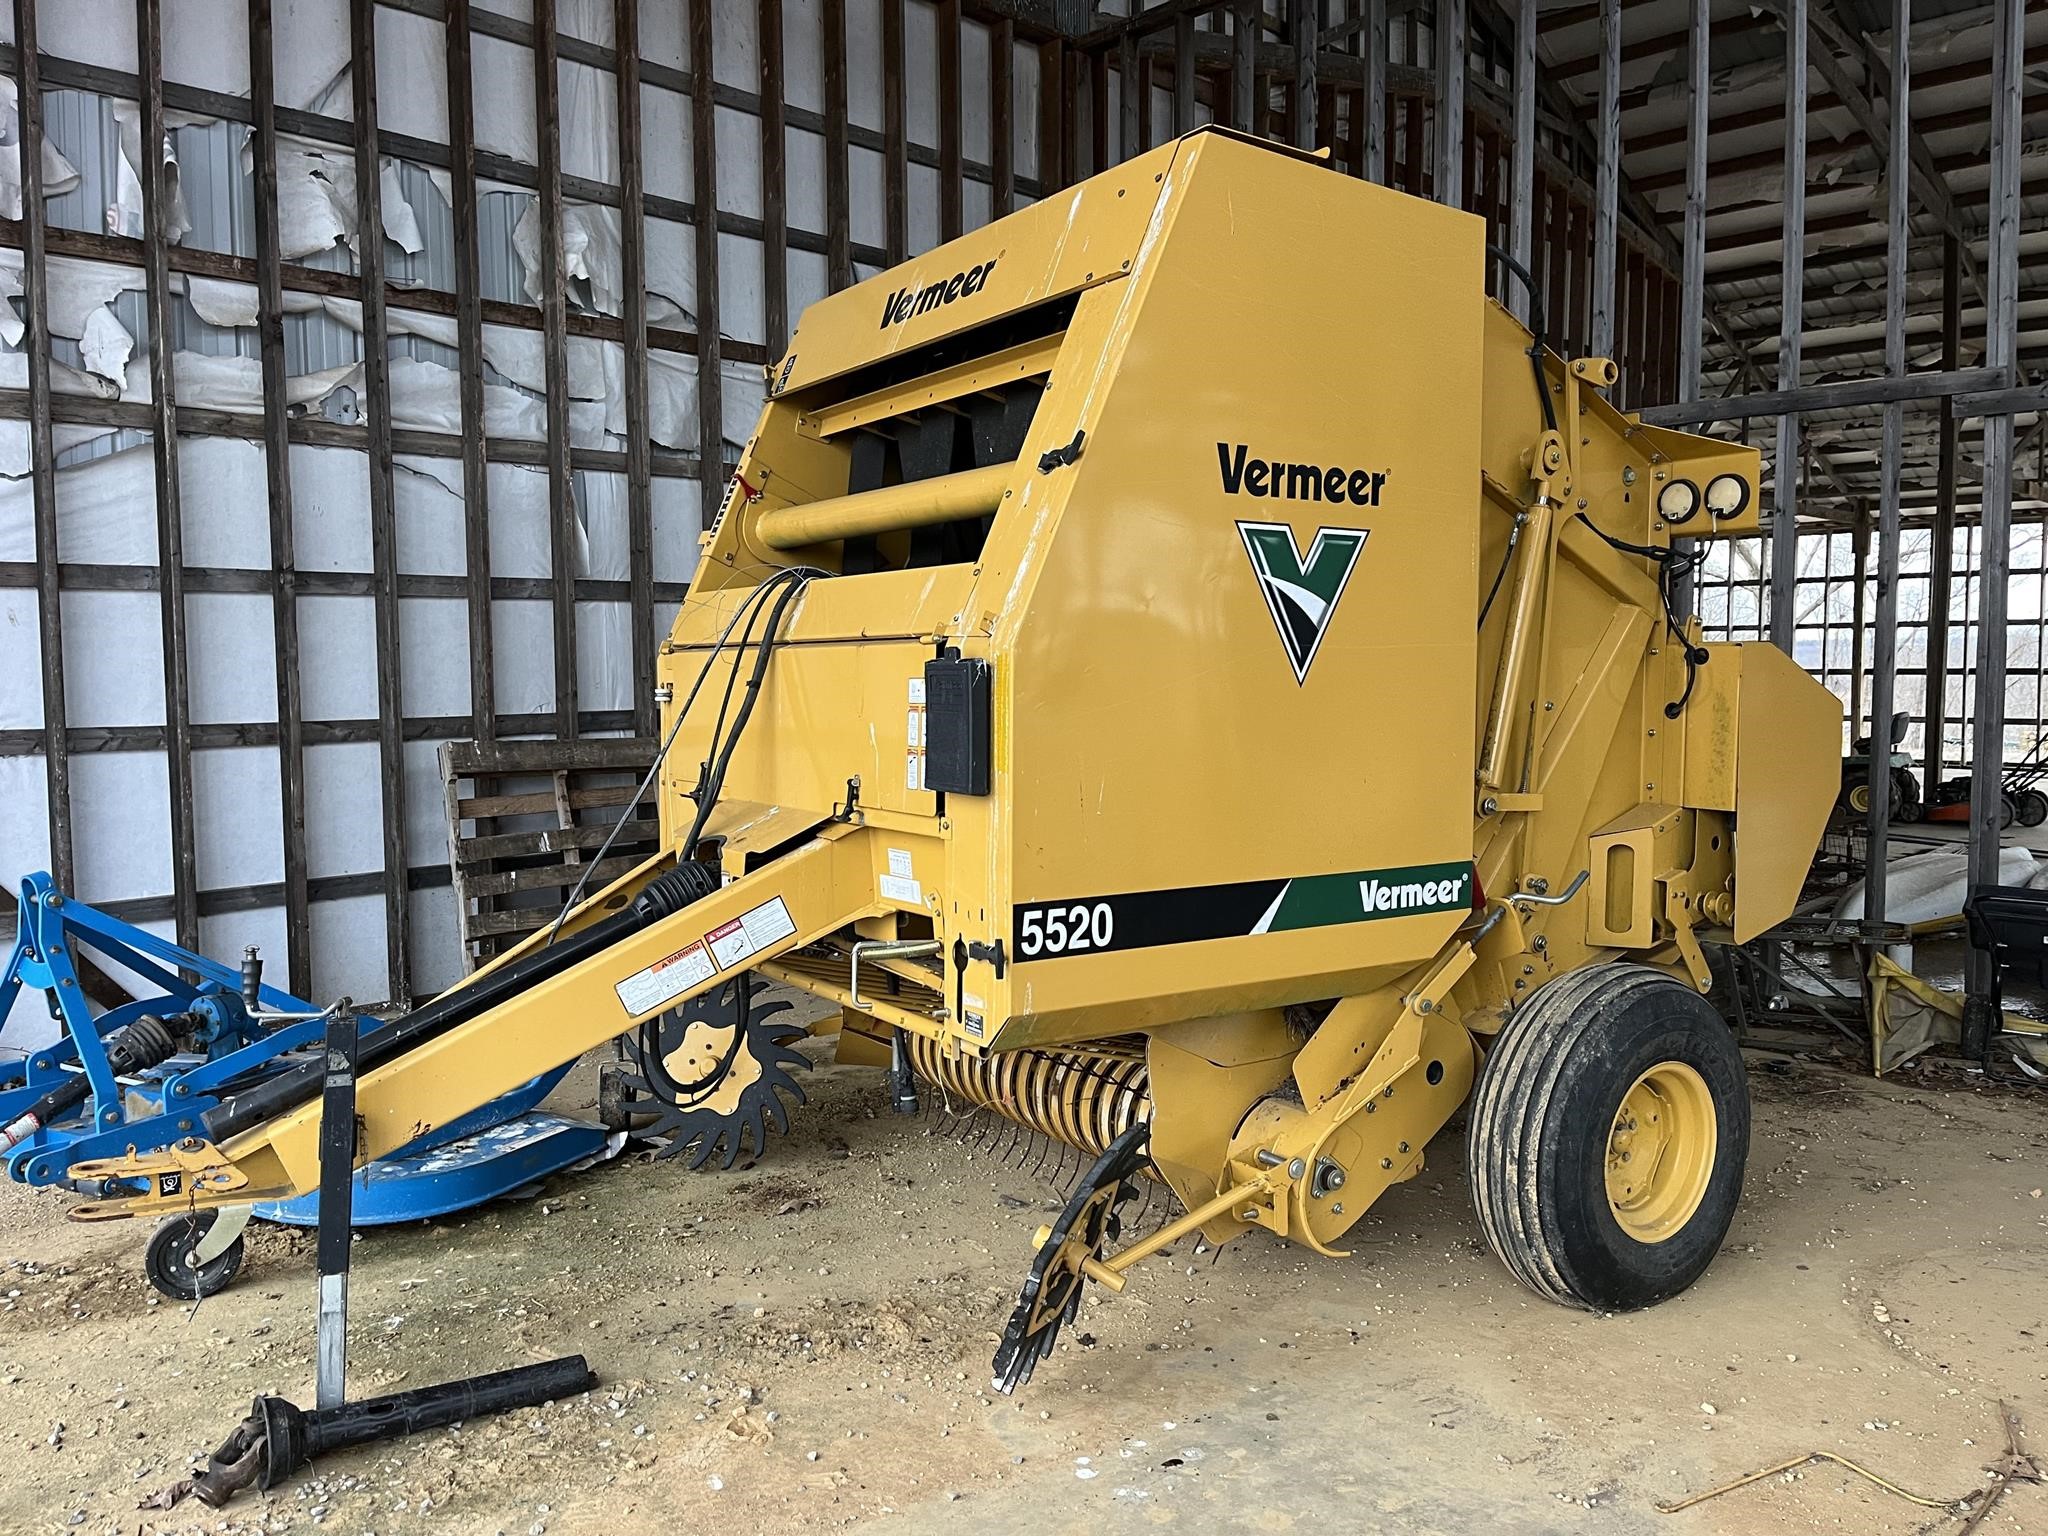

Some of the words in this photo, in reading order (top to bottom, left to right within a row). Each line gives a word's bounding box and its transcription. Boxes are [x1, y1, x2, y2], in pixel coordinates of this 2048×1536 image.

[880, 258, 998, 330] Vermeer
[1216, 442, 1387, 507] Vermeer
[1359, 877, 1464, 913] Vermeer
[667, 943, 700, 964] WARNING
[1020, 902, 1114, 956] 5520
